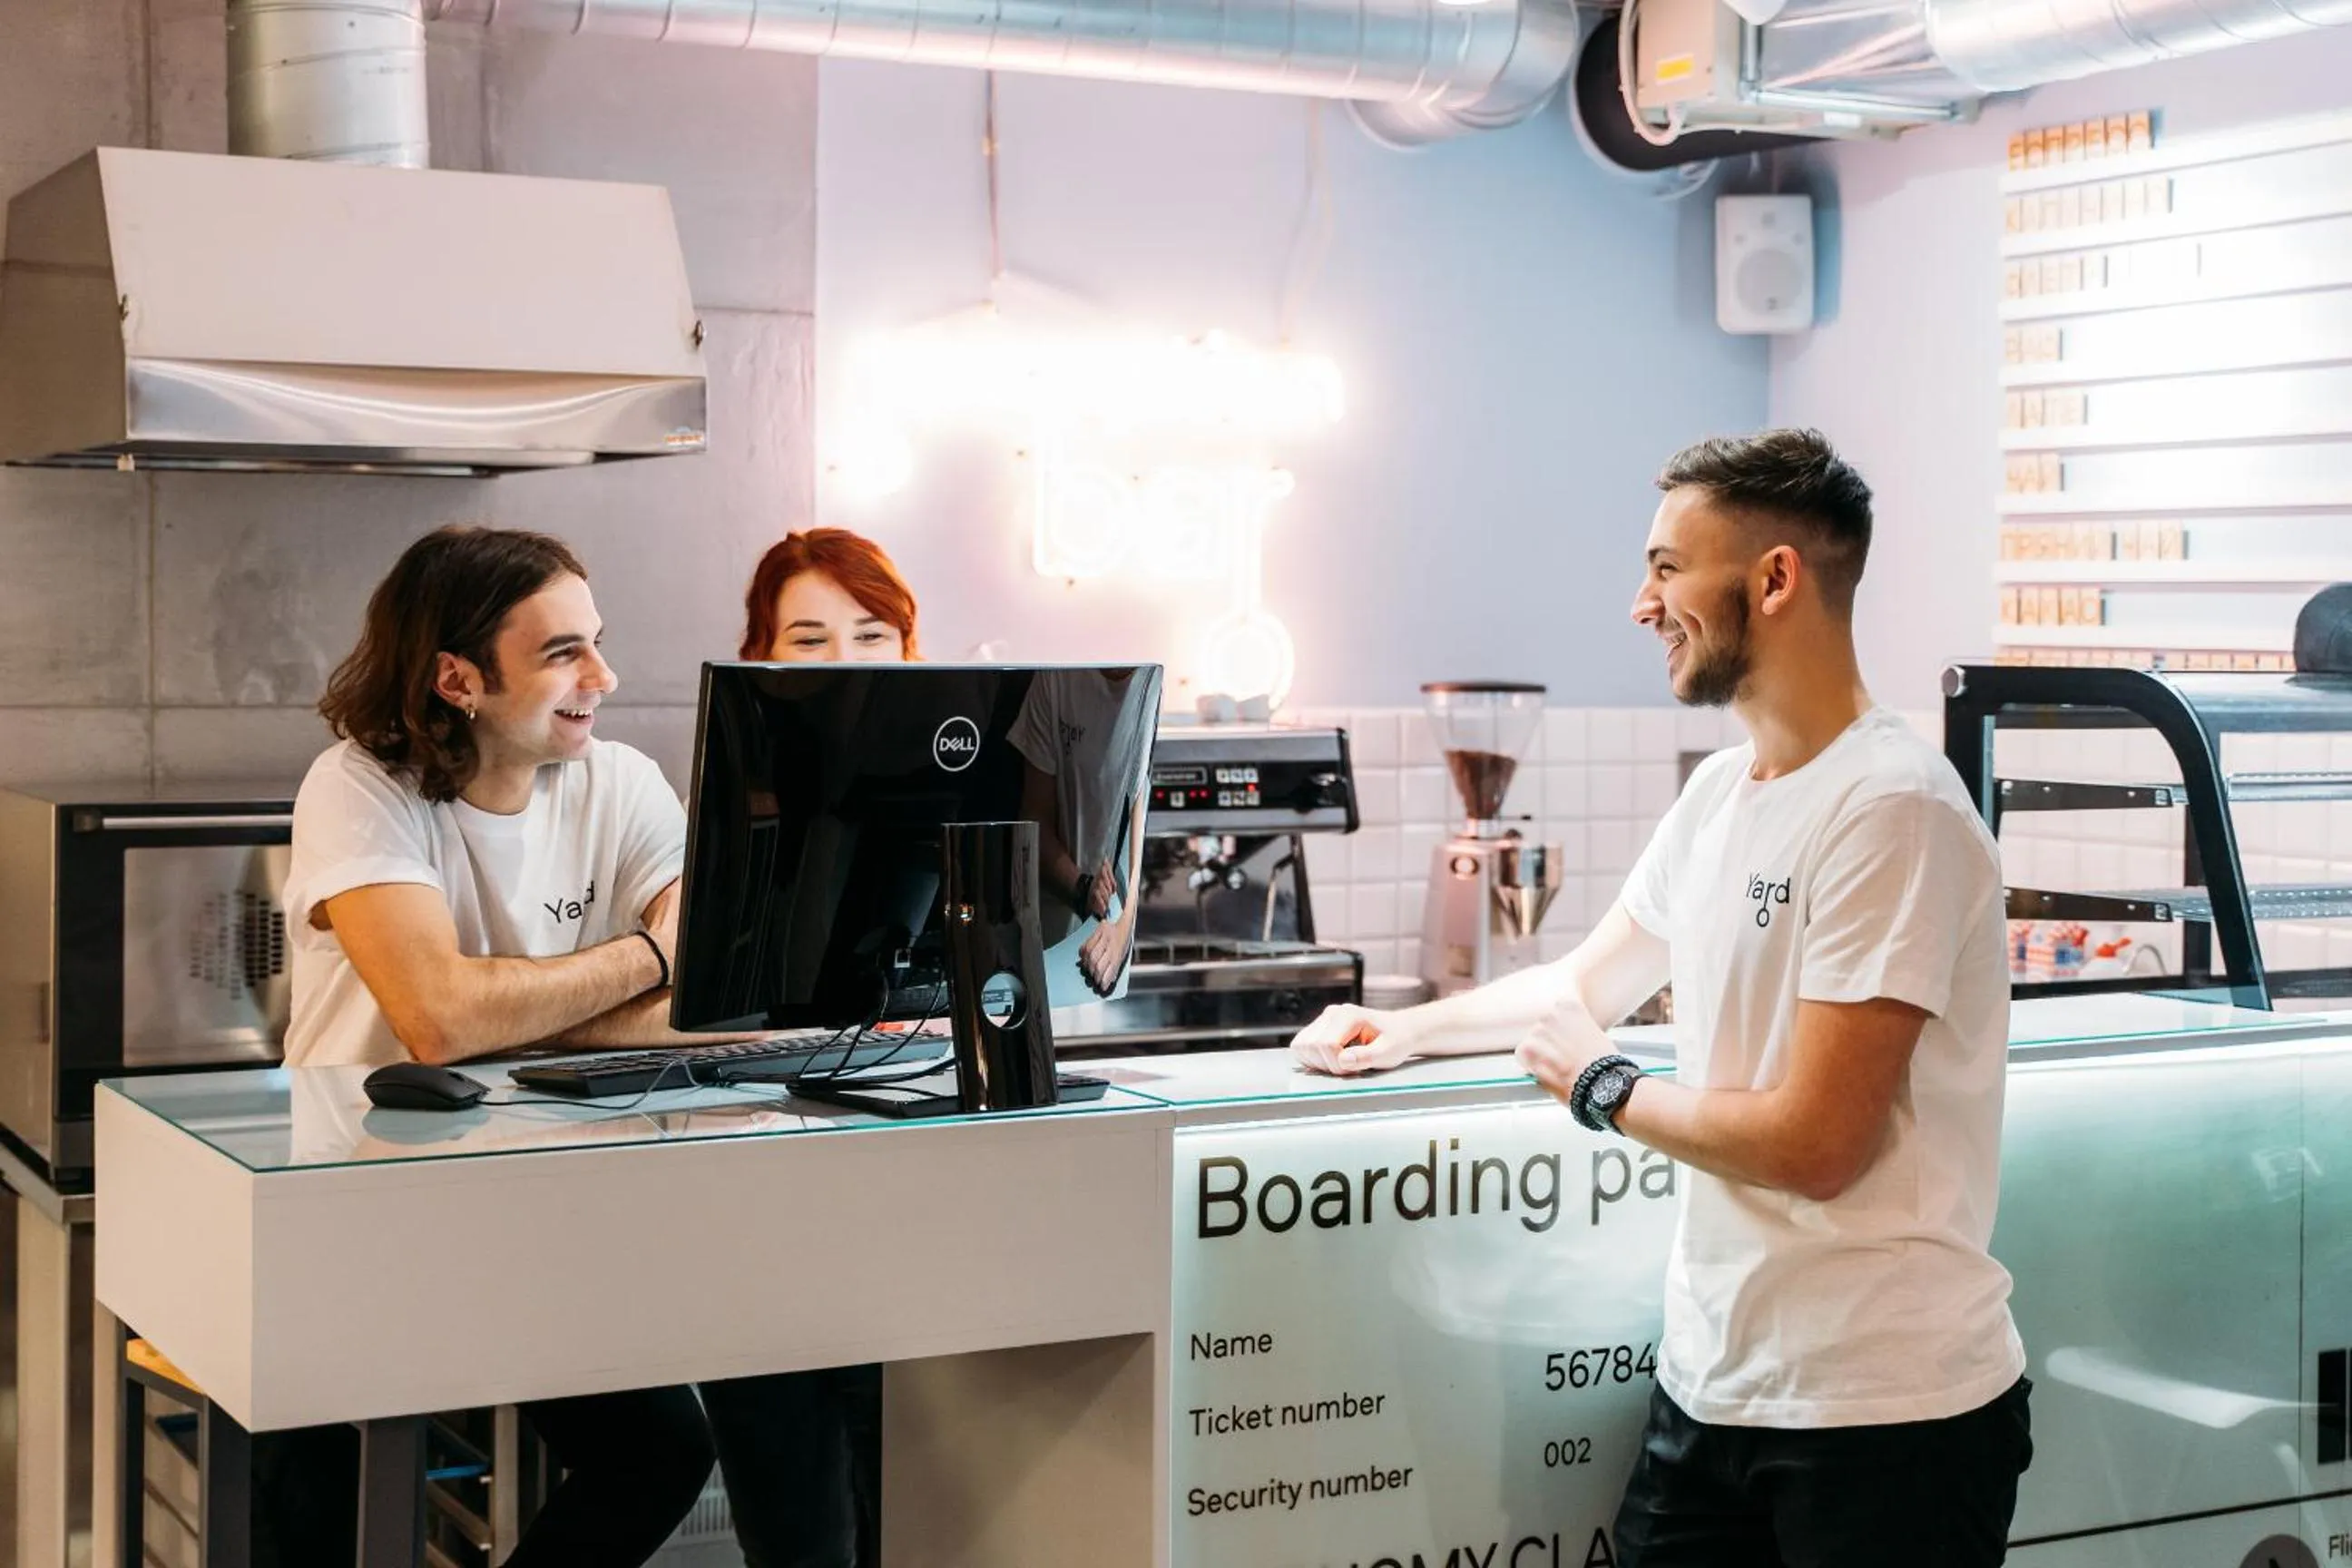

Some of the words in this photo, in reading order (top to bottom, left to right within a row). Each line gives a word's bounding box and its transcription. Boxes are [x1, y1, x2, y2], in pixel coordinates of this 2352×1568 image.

[938, 737, 975, 752] DELL
[544, 880, 595, 924] Yad
[1746, 872, 1791, 927] Yard
[1197, 1138, 1561, 1240] Boarding
[1191, 1331, 1273, 1361] Name
[1545, 1342, 1657, 1391] 56784
[1189, 1404, 1273, 1437] Ticket
[1281, 1392, 1386, 1426] number
[1544, 1436, 1592, 1468] 002
[1188, 1478, 1302, 1516] Security
[1309, 1465, 1414, 1499] number
[2329, 1534, 2352, 1561] Fli
